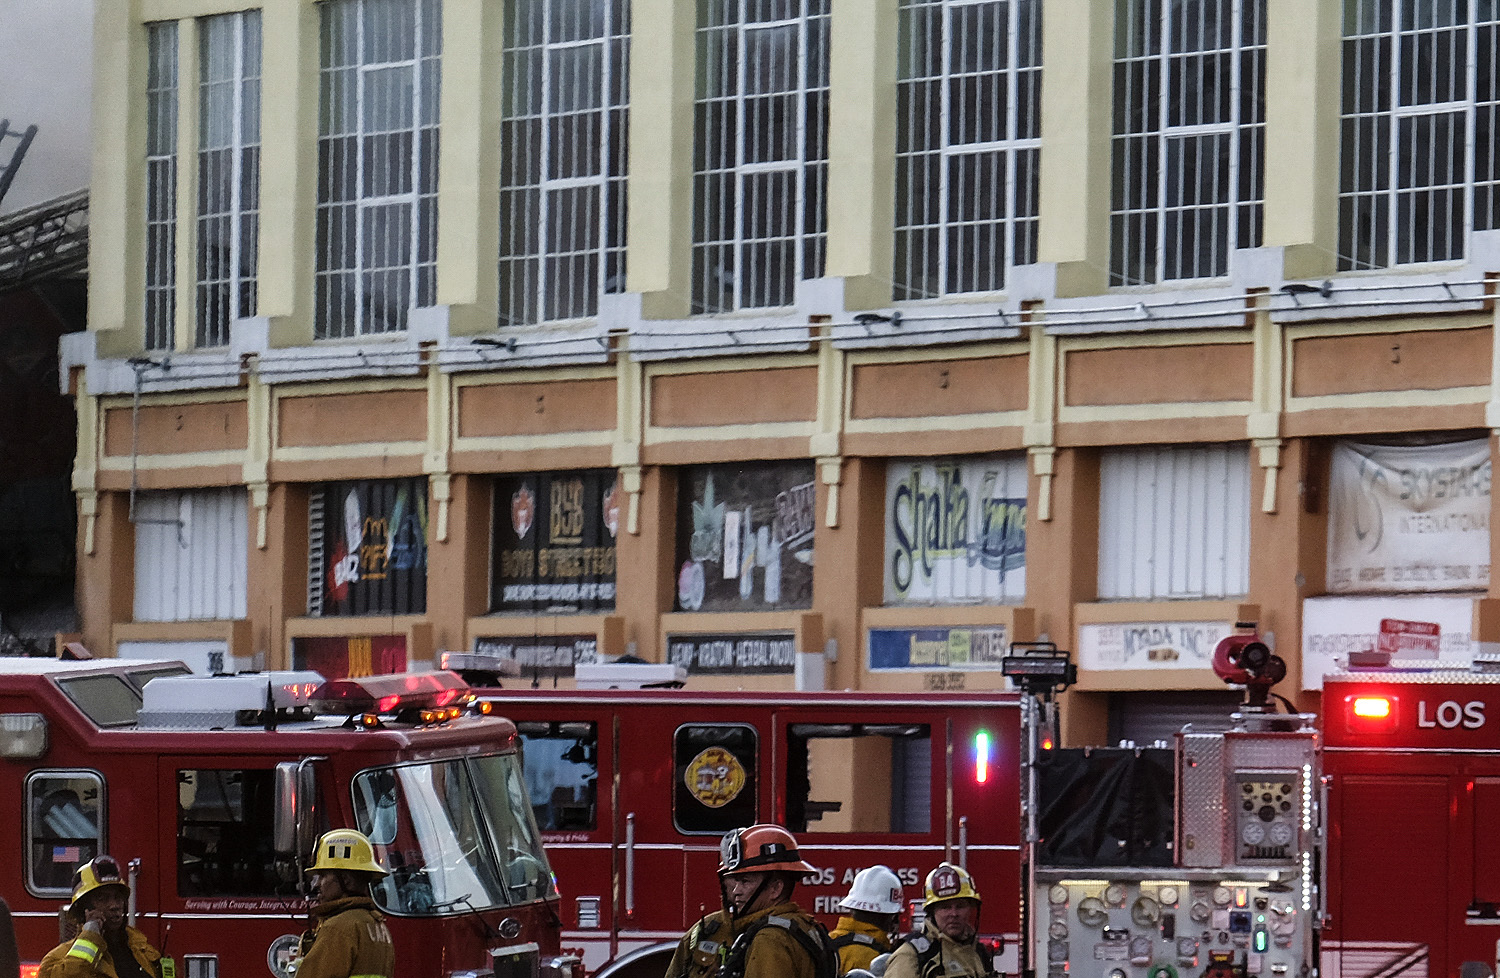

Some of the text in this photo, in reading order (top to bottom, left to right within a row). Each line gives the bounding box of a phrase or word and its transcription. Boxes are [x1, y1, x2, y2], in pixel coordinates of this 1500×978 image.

[1418, 701, 1485, 728] LOS
[185, 900, 211, 911] Serving
[213, 900, 227, 911] with
